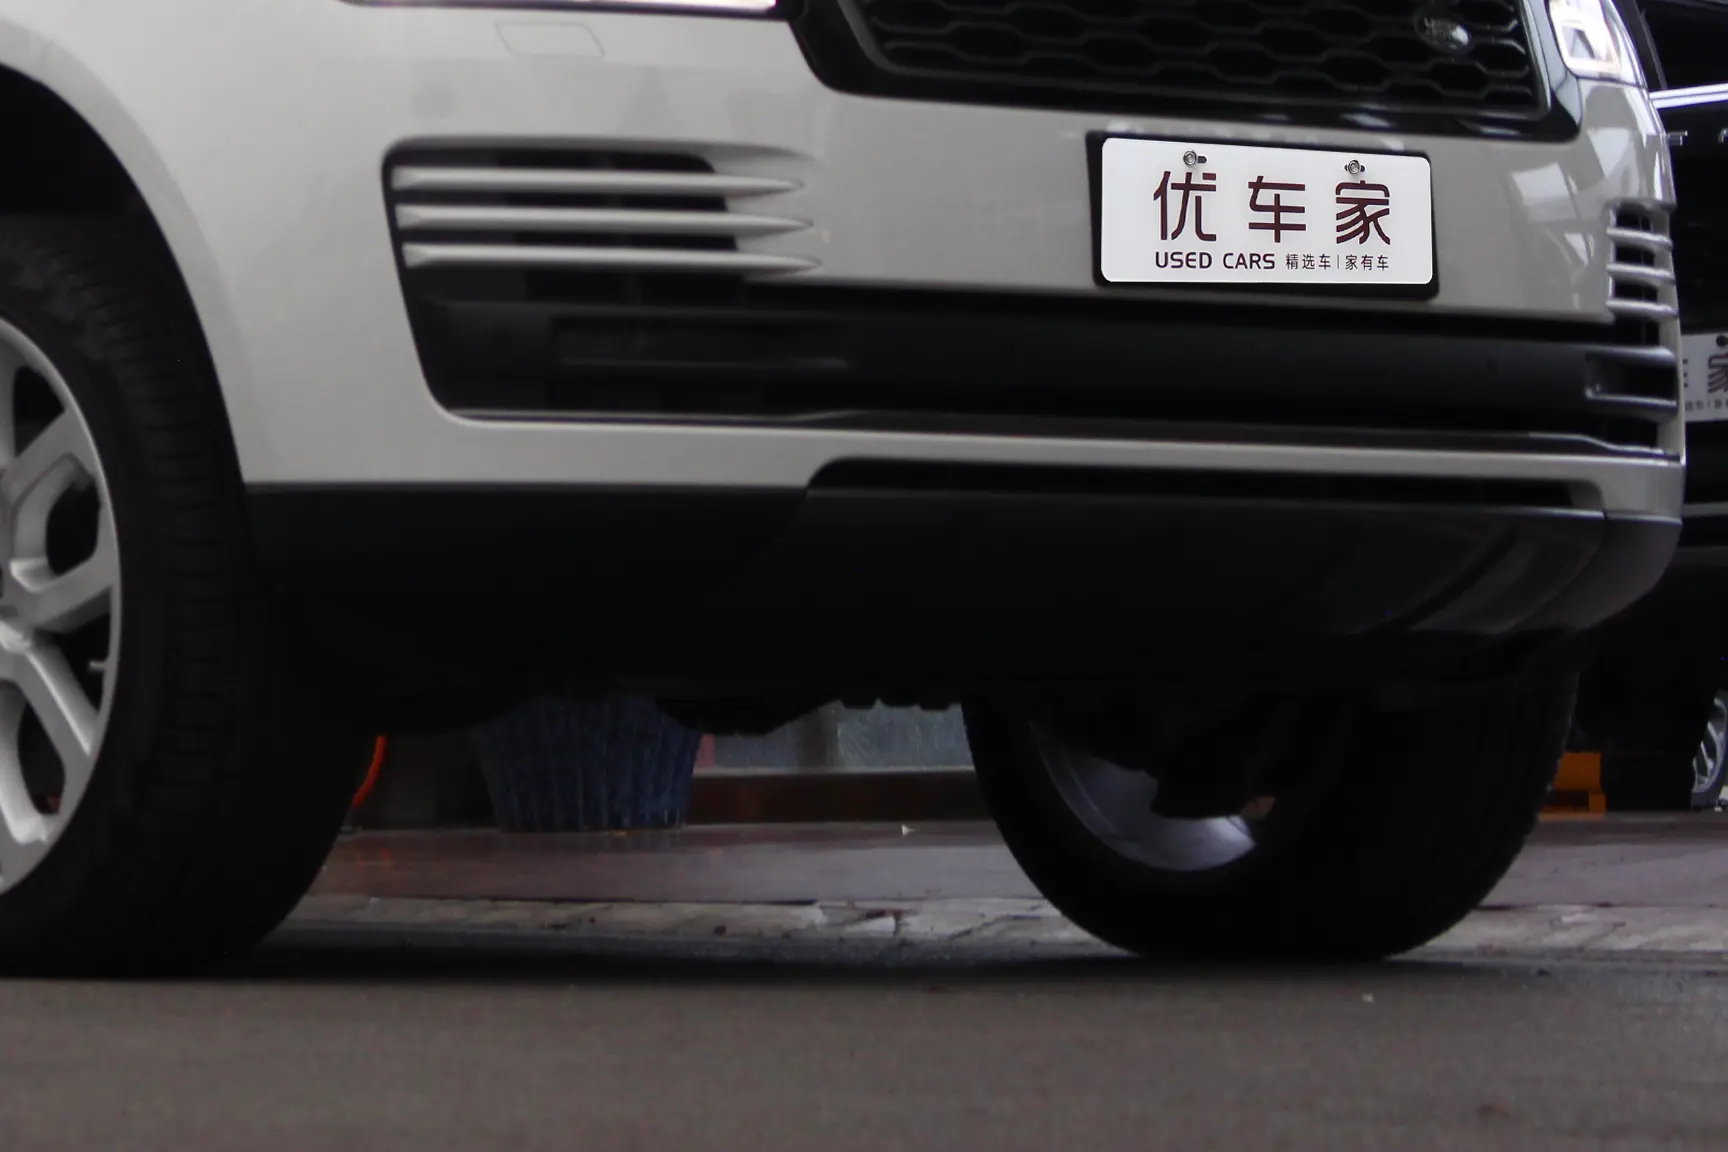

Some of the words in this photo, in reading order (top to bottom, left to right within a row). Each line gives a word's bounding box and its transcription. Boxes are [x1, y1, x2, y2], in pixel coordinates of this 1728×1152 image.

[1153, 170, 1391, 246] 优车家
[1155, 251, 1213, 270] USED
[1222, 252, 1276, 271] CARS
